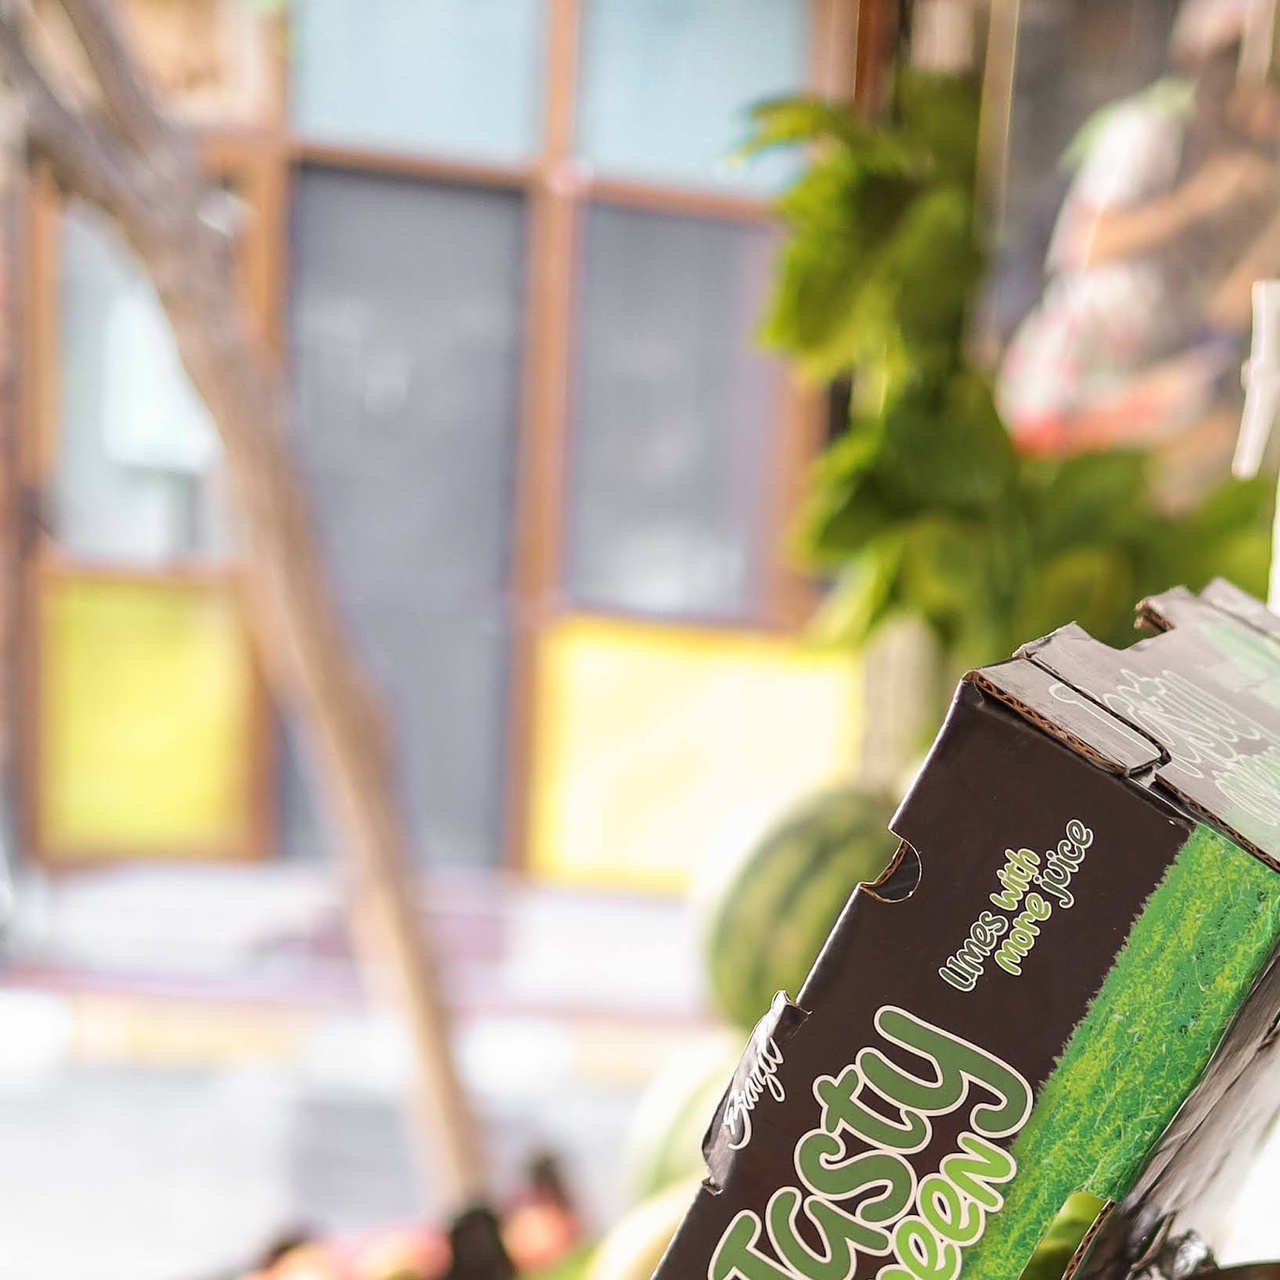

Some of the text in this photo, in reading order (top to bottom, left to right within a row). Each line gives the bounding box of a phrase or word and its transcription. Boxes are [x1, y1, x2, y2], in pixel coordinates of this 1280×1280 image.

[990, 849, 1041, 911] with
[994, 819, 1093, 976] more juice
